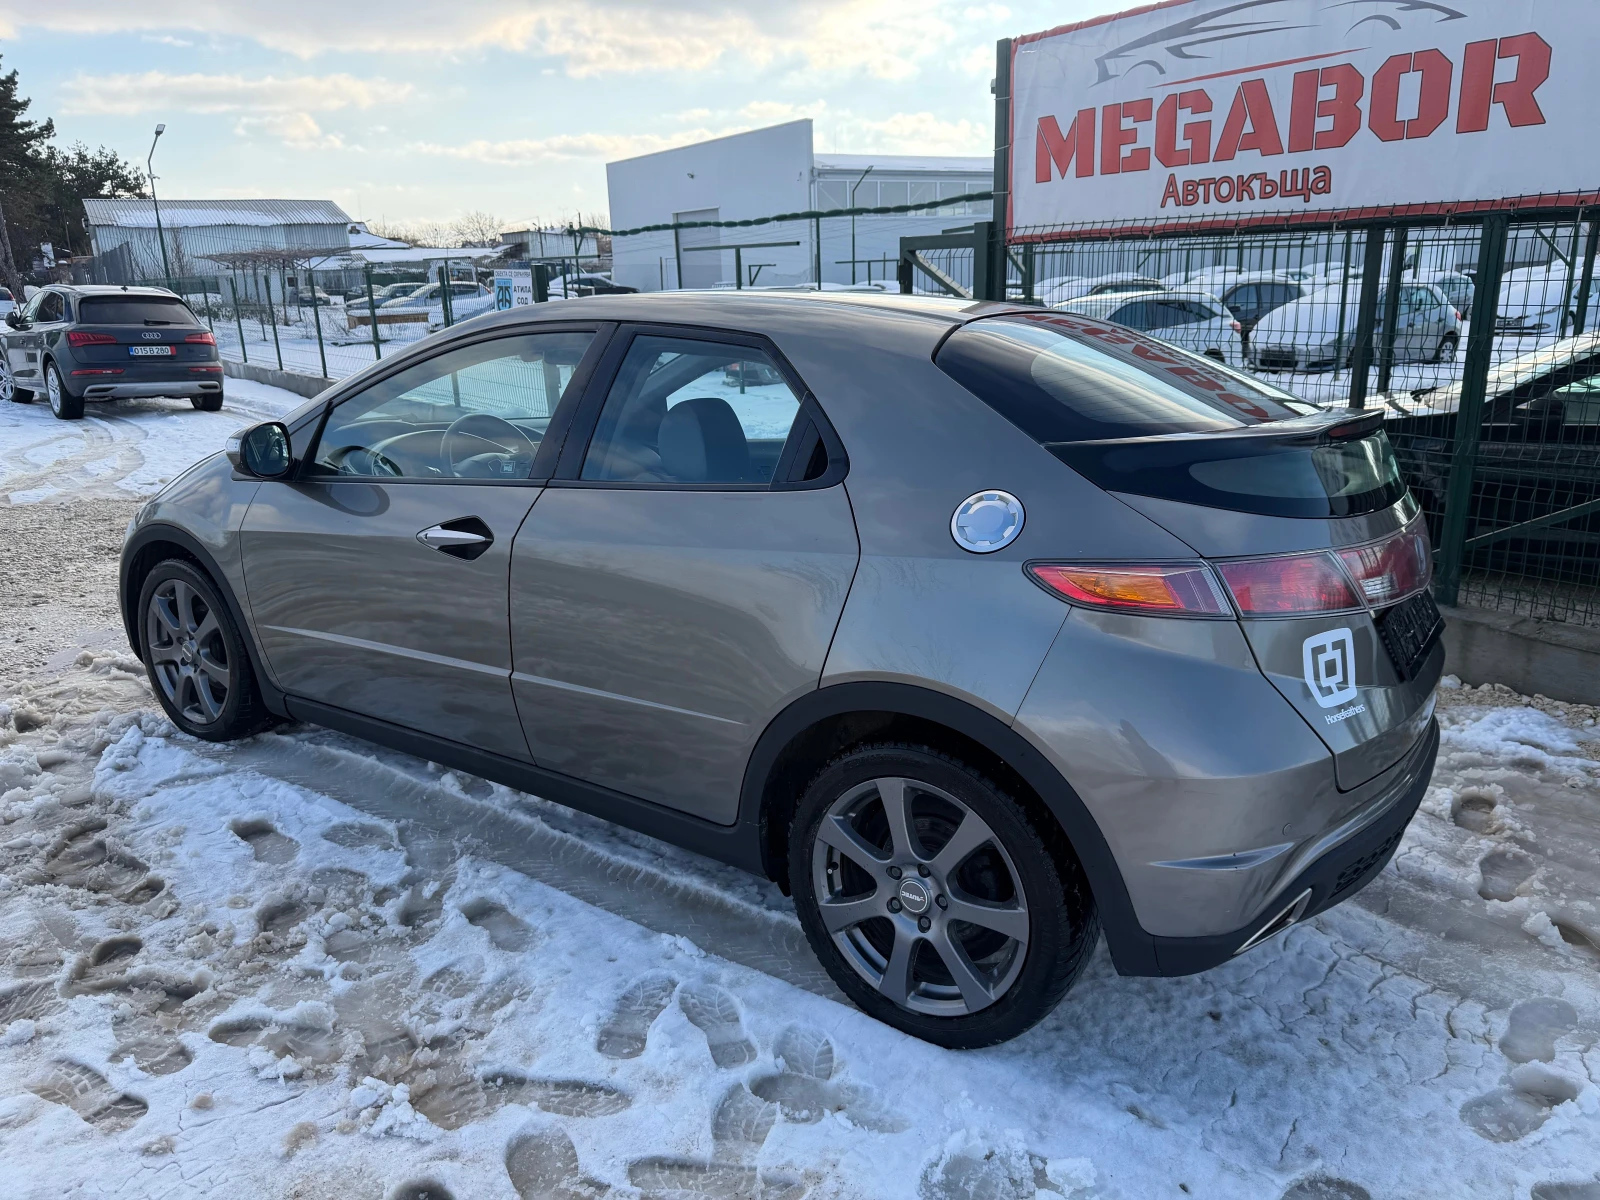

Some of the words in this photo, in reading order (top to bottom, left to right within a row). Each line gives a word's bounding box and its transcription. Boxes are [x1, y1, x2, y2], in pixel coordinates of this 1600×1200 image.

[1035, 32, 1552, 184] MEGABOR
[1160, 165, 1332, 208] Автокъща
[517, 296, 529, 305] СОД
[1324, 703, 1366, 725] Horsefeathers
